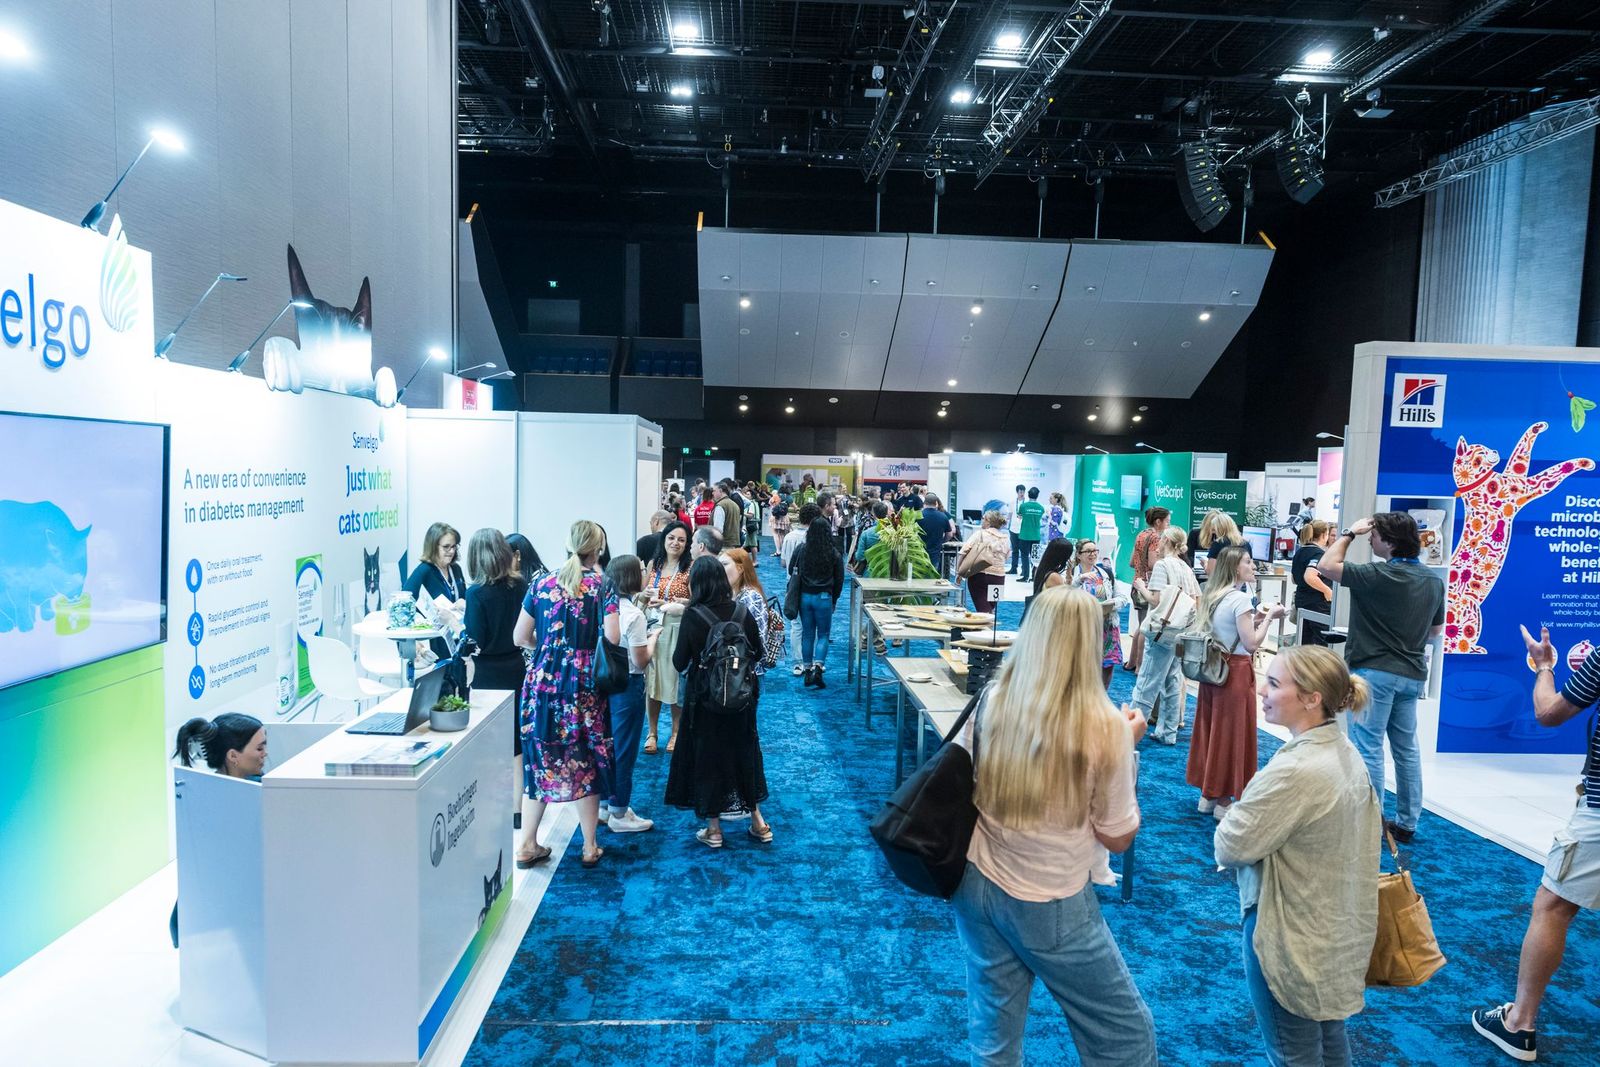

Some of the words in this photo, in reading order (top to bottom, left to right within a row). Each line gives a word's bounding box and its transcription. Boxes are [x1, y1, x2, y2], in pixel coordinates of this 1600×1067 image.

[1399, 408, 1436, 422] Hill's
[353, 431, 378, 453] Senvelgo
[184, 469, 193, 489] A
[196, 473, 219, 489] new
[222, 473, 238, 488] era
[241, 468, 251, 487] of
[253, 468, 306, 487] convenience
[346, 465, 366, 497] Just
[368, 465, 392, 490] what
[1156, 485, 1184, 501] VetScript
[1197, 492, 1237, 501] VetScript
[185, 501, 196, 523] in
[199, 500, 245, 522] diabetes
[247, 497, 304, 519] management
[339, 510, 361, 535] cats
[363, 504, 399, 531] ordered
[1534, 525, 1600, 538] technolo
[1549, 541, 1600, 553] whole-
[207, 561, 219, 571] Once
[220, 558, 231, 569] daily
[207, 576, 218, 584] with
[224, 572, 241, 581] without
[240, 569, 253, 577] food
[1562, 572, 1578, 583] at
[993, 587, 999, 599] 3
[209, 664, 217, 674] No
[217, 662, 229, 671] dose
[447, 779, 477, 824] Boehringer
[447, 807, 475, 851] Ingelheim
